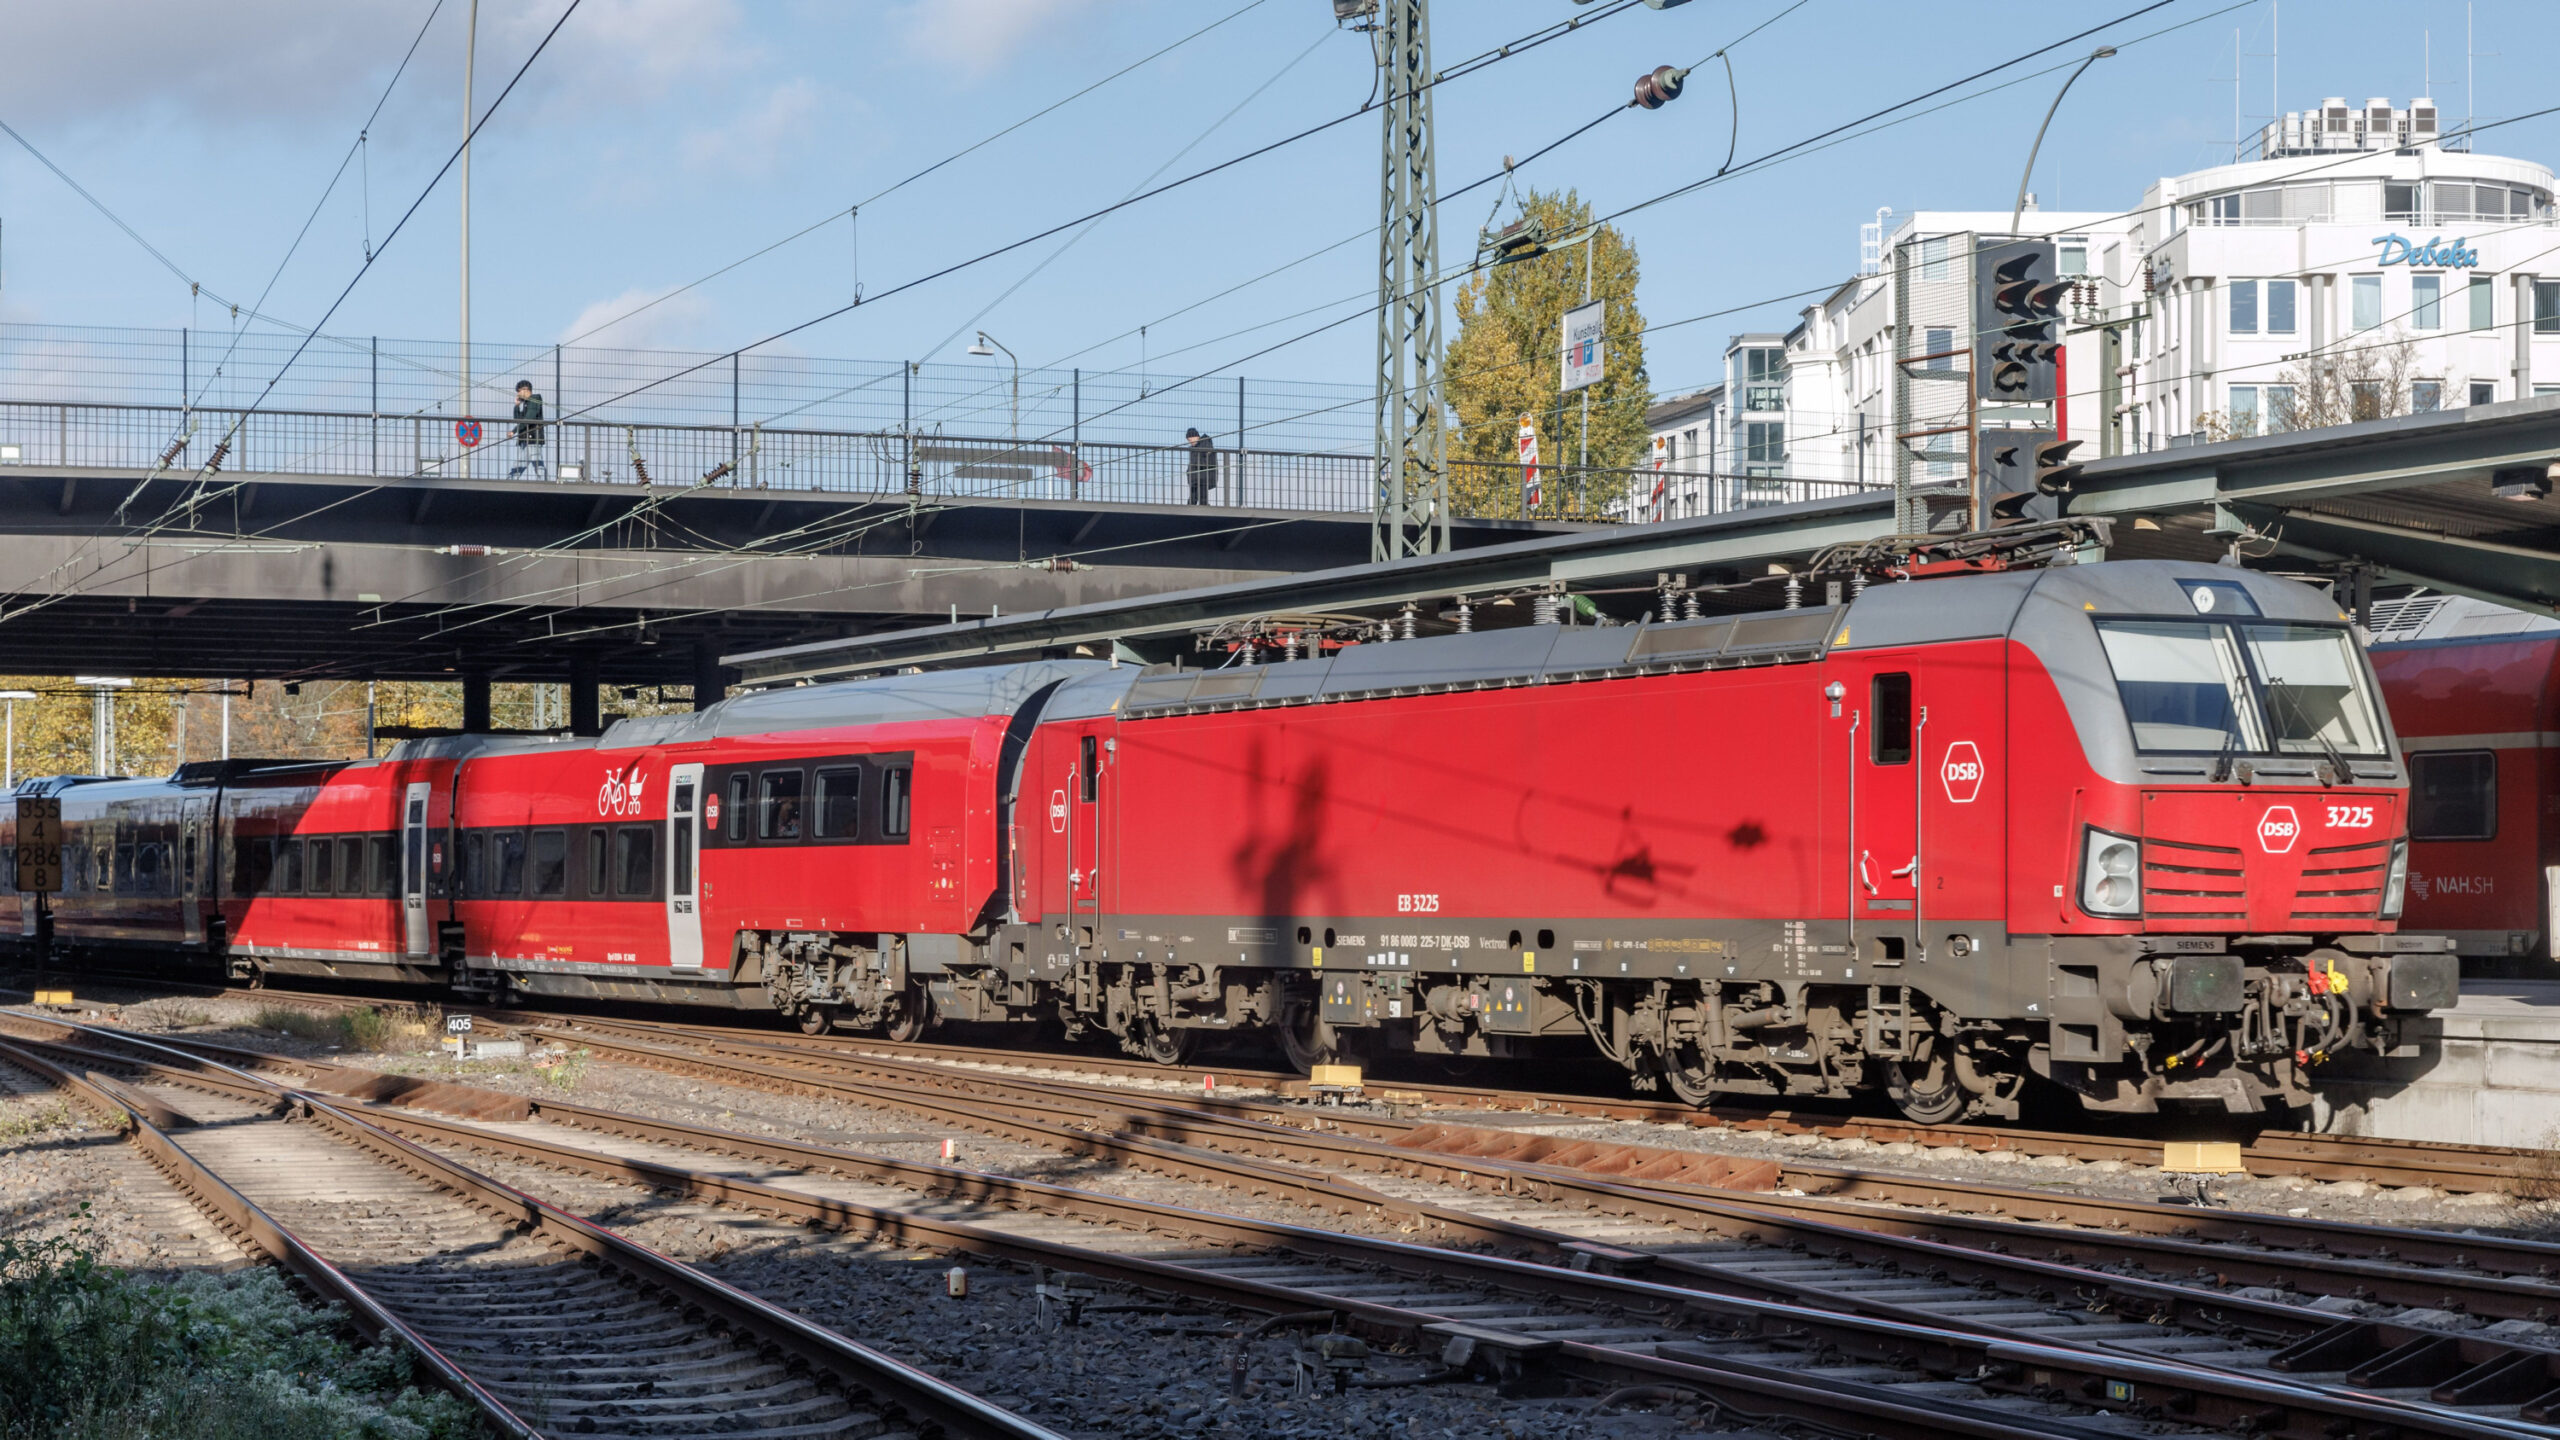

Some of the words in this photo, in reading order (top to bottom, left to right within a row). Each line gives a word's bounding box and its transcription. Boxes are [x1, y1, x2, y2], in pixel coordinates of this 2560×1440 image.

[2372, 233, 2478, 269] Debeka
[1948, 762, 1978, 781] DSB
[20, 800, 60, 818] 355
[706, 805, 718, 817] DSB
[1052, 804, 1065, 818] DSB
[2325, 806, 2374, 828] 3225
[31, 821, 45, 839] 4
[2264, 822, 2294, 836] DSB
[21, 846, 60, 867] 286
[34, 868, 47, 887] 8
[1937, 876, 1944, 889] 2
[2436, 876, 2494, 894] NAH.SH
[1398, 894, 1411, 912] EB
[1413, 894, 1439, 912] 3225
[1336, 935, 1366, 946] SIEMENS
[1380, 934, 1389, 947] 91
[1390, 935, 1400, 947] 86
[1401, 935, 1418, 947] 0003
[1420, 935, 1440, 948] 225-7
[1441, 935, 1470, 949] DK-DSB
[1479, 936, 1508, 950] Vectron
[2176, 940, 2215, 950] SIEMENS
[449, 1018, 471, 1030] 405
